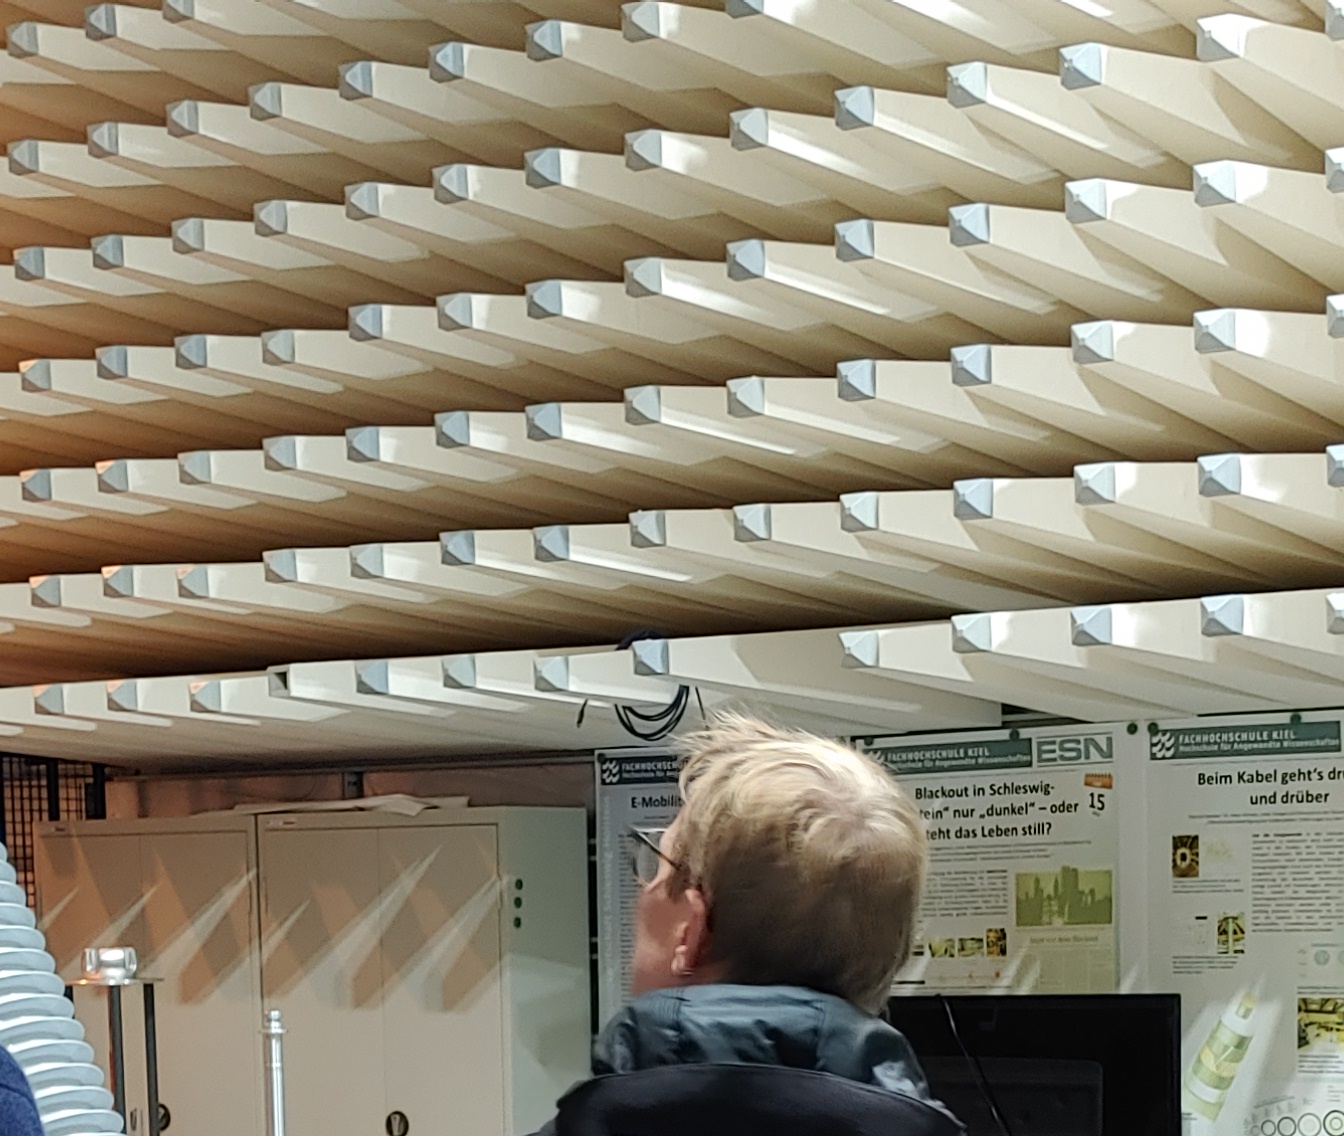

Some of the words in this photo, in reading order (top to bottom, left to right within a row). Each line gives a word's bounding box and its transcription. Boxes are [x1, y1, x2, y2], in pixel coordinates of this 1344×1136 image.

[1179, 730, 1269, 744] FACHHOCHSCHULE
[1272, 729, 1297, 740] KIEL
[888, 748, 965, 762] FACHHOCHSCHULE
[968, 746, 990, 758] KIEL
[1037, 735, 1113, 763] ESN
[1198, 772, 1233, 786] Beim
[1237, 769, 1277, 784] Kabel
[915, 784, 969, 800] Blackout
[973, 783, 986, 797] in
[989, 780, 1056, 797] Schleswig-
[1249, 791, 1278, 806] und
[1281, 790, 1330, 805] drüber
[953, 808, 976, 819] nur
[1050, 801, 1080, 814] oder
[1088, 792, 1106, 811] 15
[926, 826, 952, 841] teht
[955, 826, 978, 839] das
[981, 824, 1019, 839] Leben
[1021, 822, 1053, 837] still?
